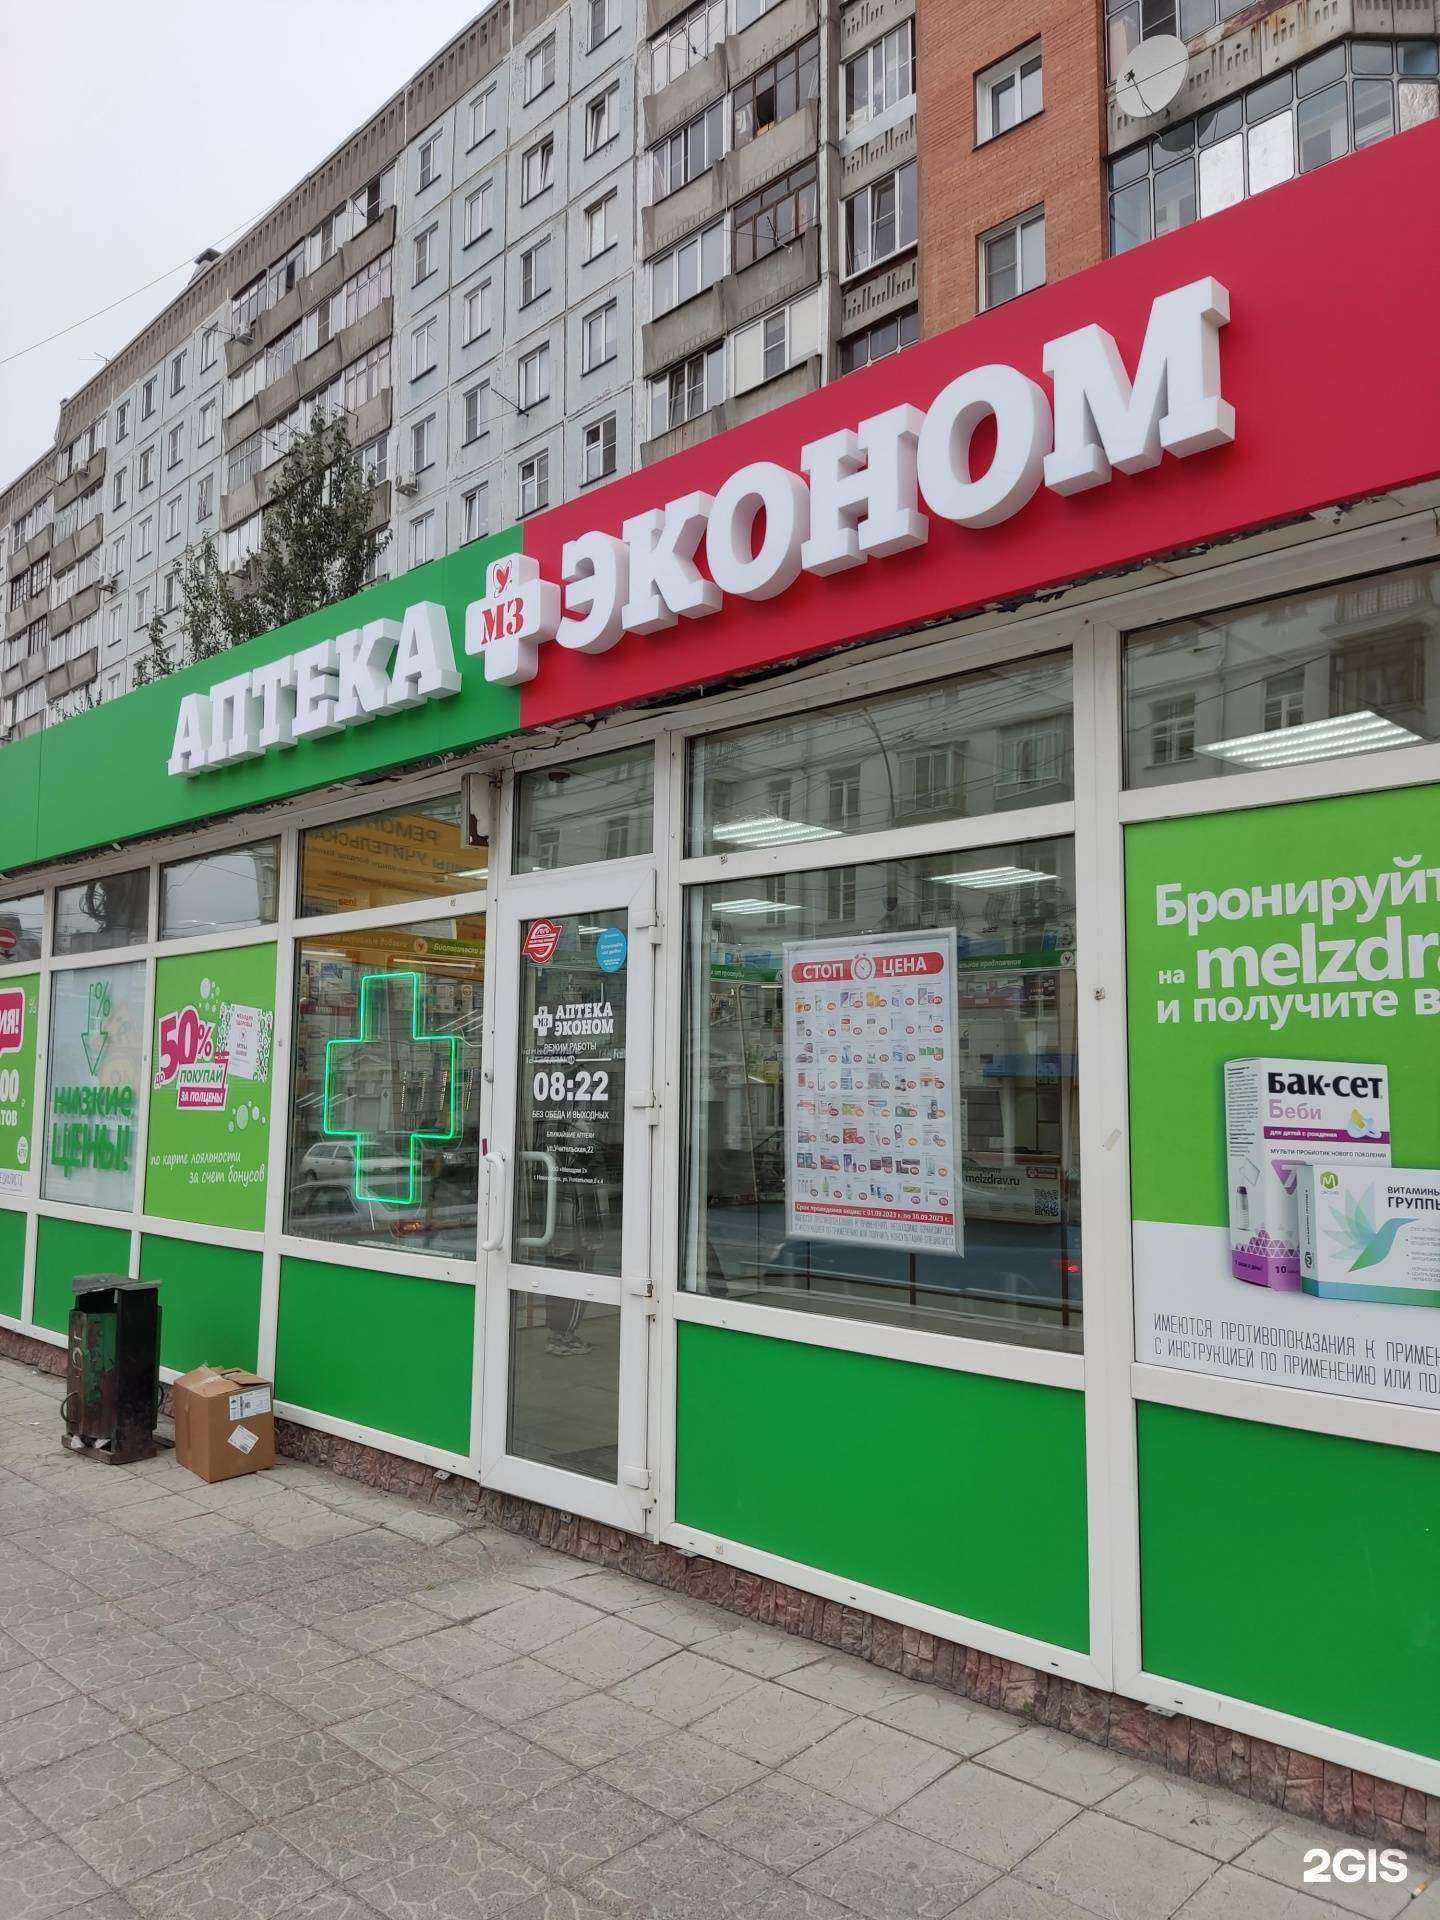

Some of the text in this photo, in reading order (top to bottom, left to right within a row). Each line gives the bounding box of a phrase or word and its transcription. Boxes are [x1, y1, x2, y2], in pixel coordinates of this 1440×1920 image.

[167, 276, 1235, 778] АПТЕКА ЭКОНОМ
[481, 601, 524, 645] МЗ
[1158, 916, 1440, 989] на melzdr
[803, 956, 928, 980] СТОП ЦЕНА
[555, 1002, 613, 1019] АПТЕКА
[1157, 999, 1180, 1023] и
[1193, 989, 1399, 1031] получите
[554, 1019, 614, 1036] ЭКОНОМ
[161, 1010, 212, 1080] 50%
[544, 1042, 597, 1051] РЕЖИМ РАБОТЫ
[180, 1065, 222, 1083] ПОКУПАЙ
[533, 1071, 609, 1101] 08:22
[1268, 1072, 1383, 1099] Бак-сет
[180, 1091, 223, 1105] ЗА ПОЛЦЕНЫ
[532, 1110, 609, 1120] БЕЗ ОБЕДА И ВЫХОДНЫХ
[1269, 1099, 1322, 1120] Беби
[1270, 1129, 1282, 1137] для
[1283, 1129, 1301, 1138] детей
[1307, 1131, 1337, 1140] рождения
[151, 1151, 241, 1170] по карте лояльности
[189, 1163, 265, 1187] за счет бонусов
[965, 1174, 1020, 1186] melzdrav.ru
[1275, 1266, 1287, 1274] 10
[1154, 1312, 1212, 1338] ИМЕЮТСЯ
[1221, 1321, 1355, 1357] ПРОТИВОПОКАЗАНИЯ
[1365, 1339, 1376, 1359] К
[1154, 1337, 1162, 1355] С
[1168, 1340, 1254, 1369] ИНСТРУКЦИЕЙ
[1260, 1352, 1277, 1372] ПО
[1283, 1355, 1376, 1386] ПРИМЕНЕНИЮ
[1384, 1368, 1411, 1390] ИЛИ
